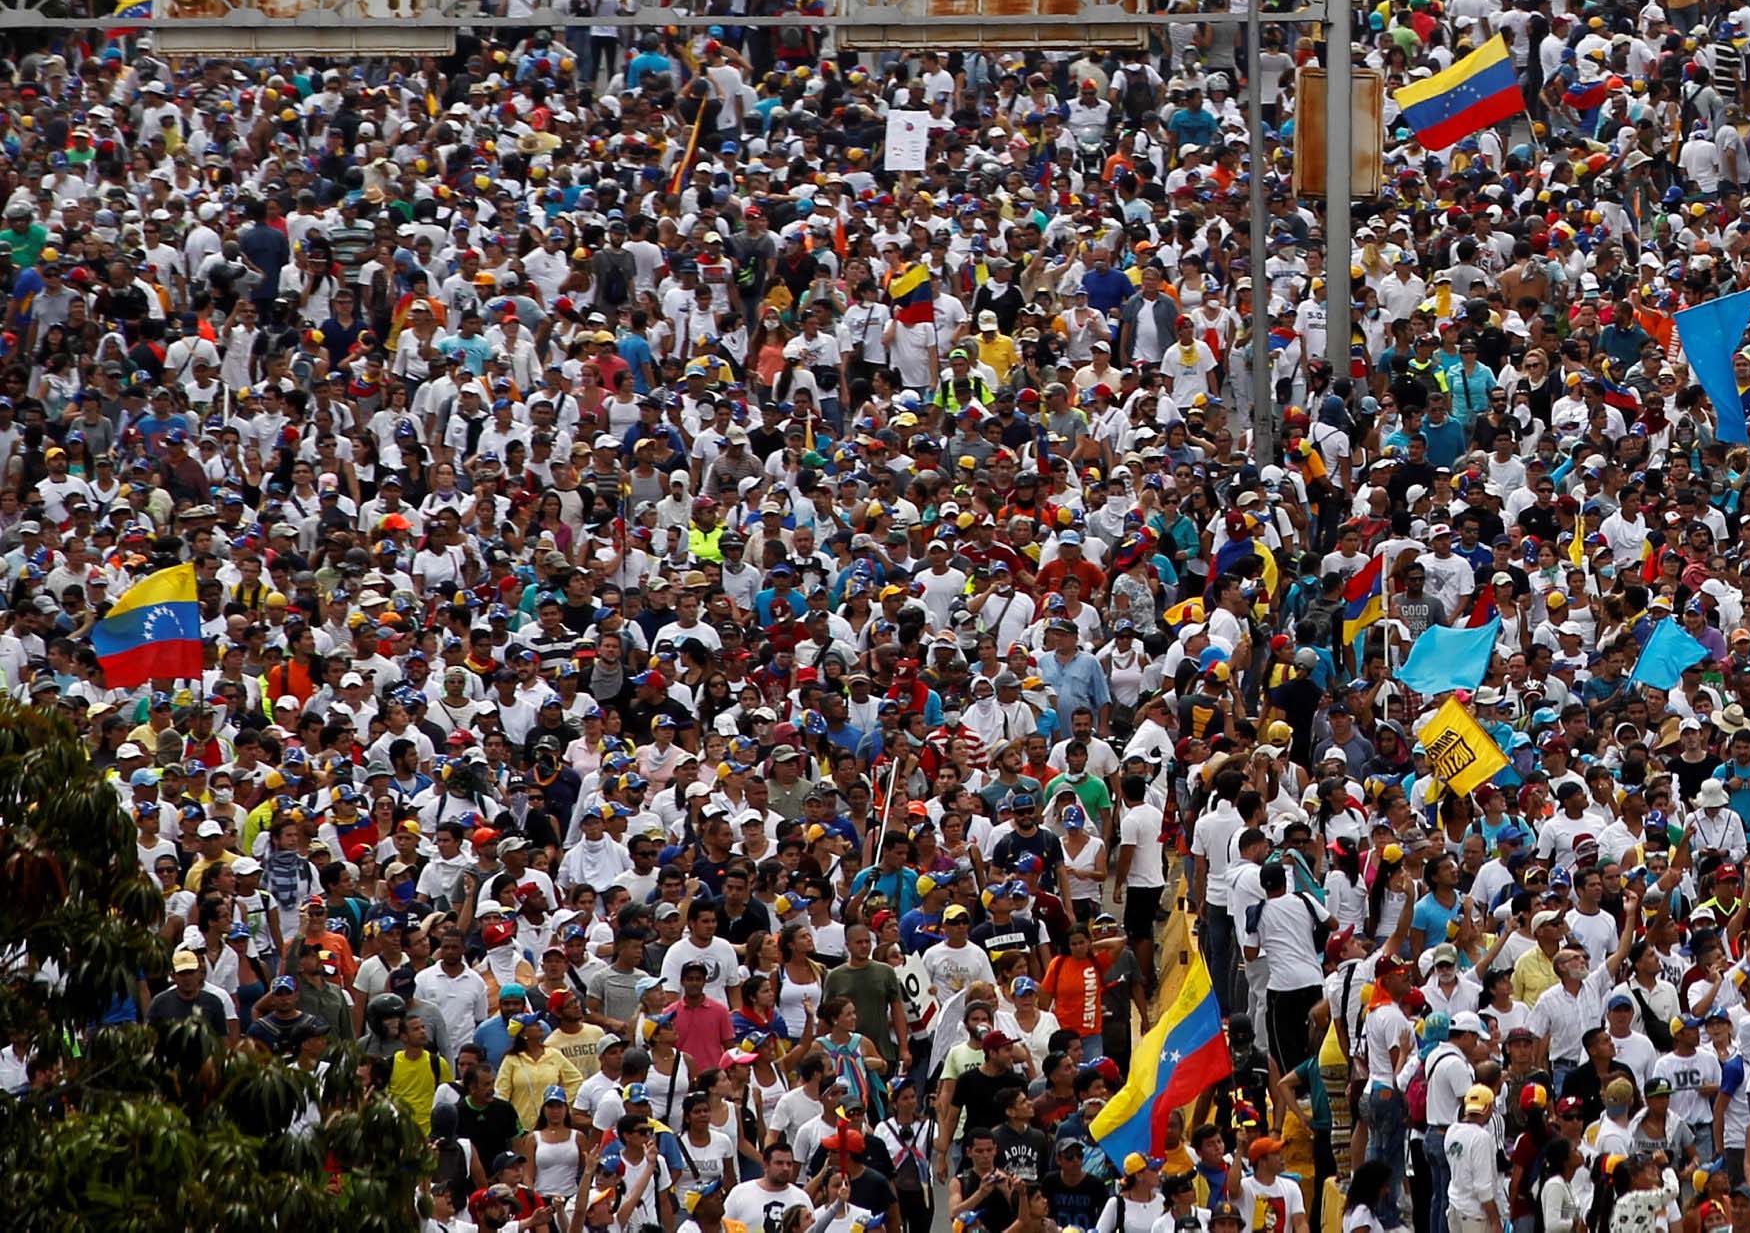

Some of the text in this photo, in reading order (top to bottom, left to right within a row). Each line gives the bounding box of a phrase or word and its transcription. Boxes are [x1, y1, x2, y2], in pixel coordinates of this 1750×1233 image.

[1401, 604, 1429, 616] GOOD
[1083, 966, 1097, 1029] UNIMET
[1674, 1069, 1701, 1087] UC
[1004, 1145, 1038, 1161] ADIDAS
